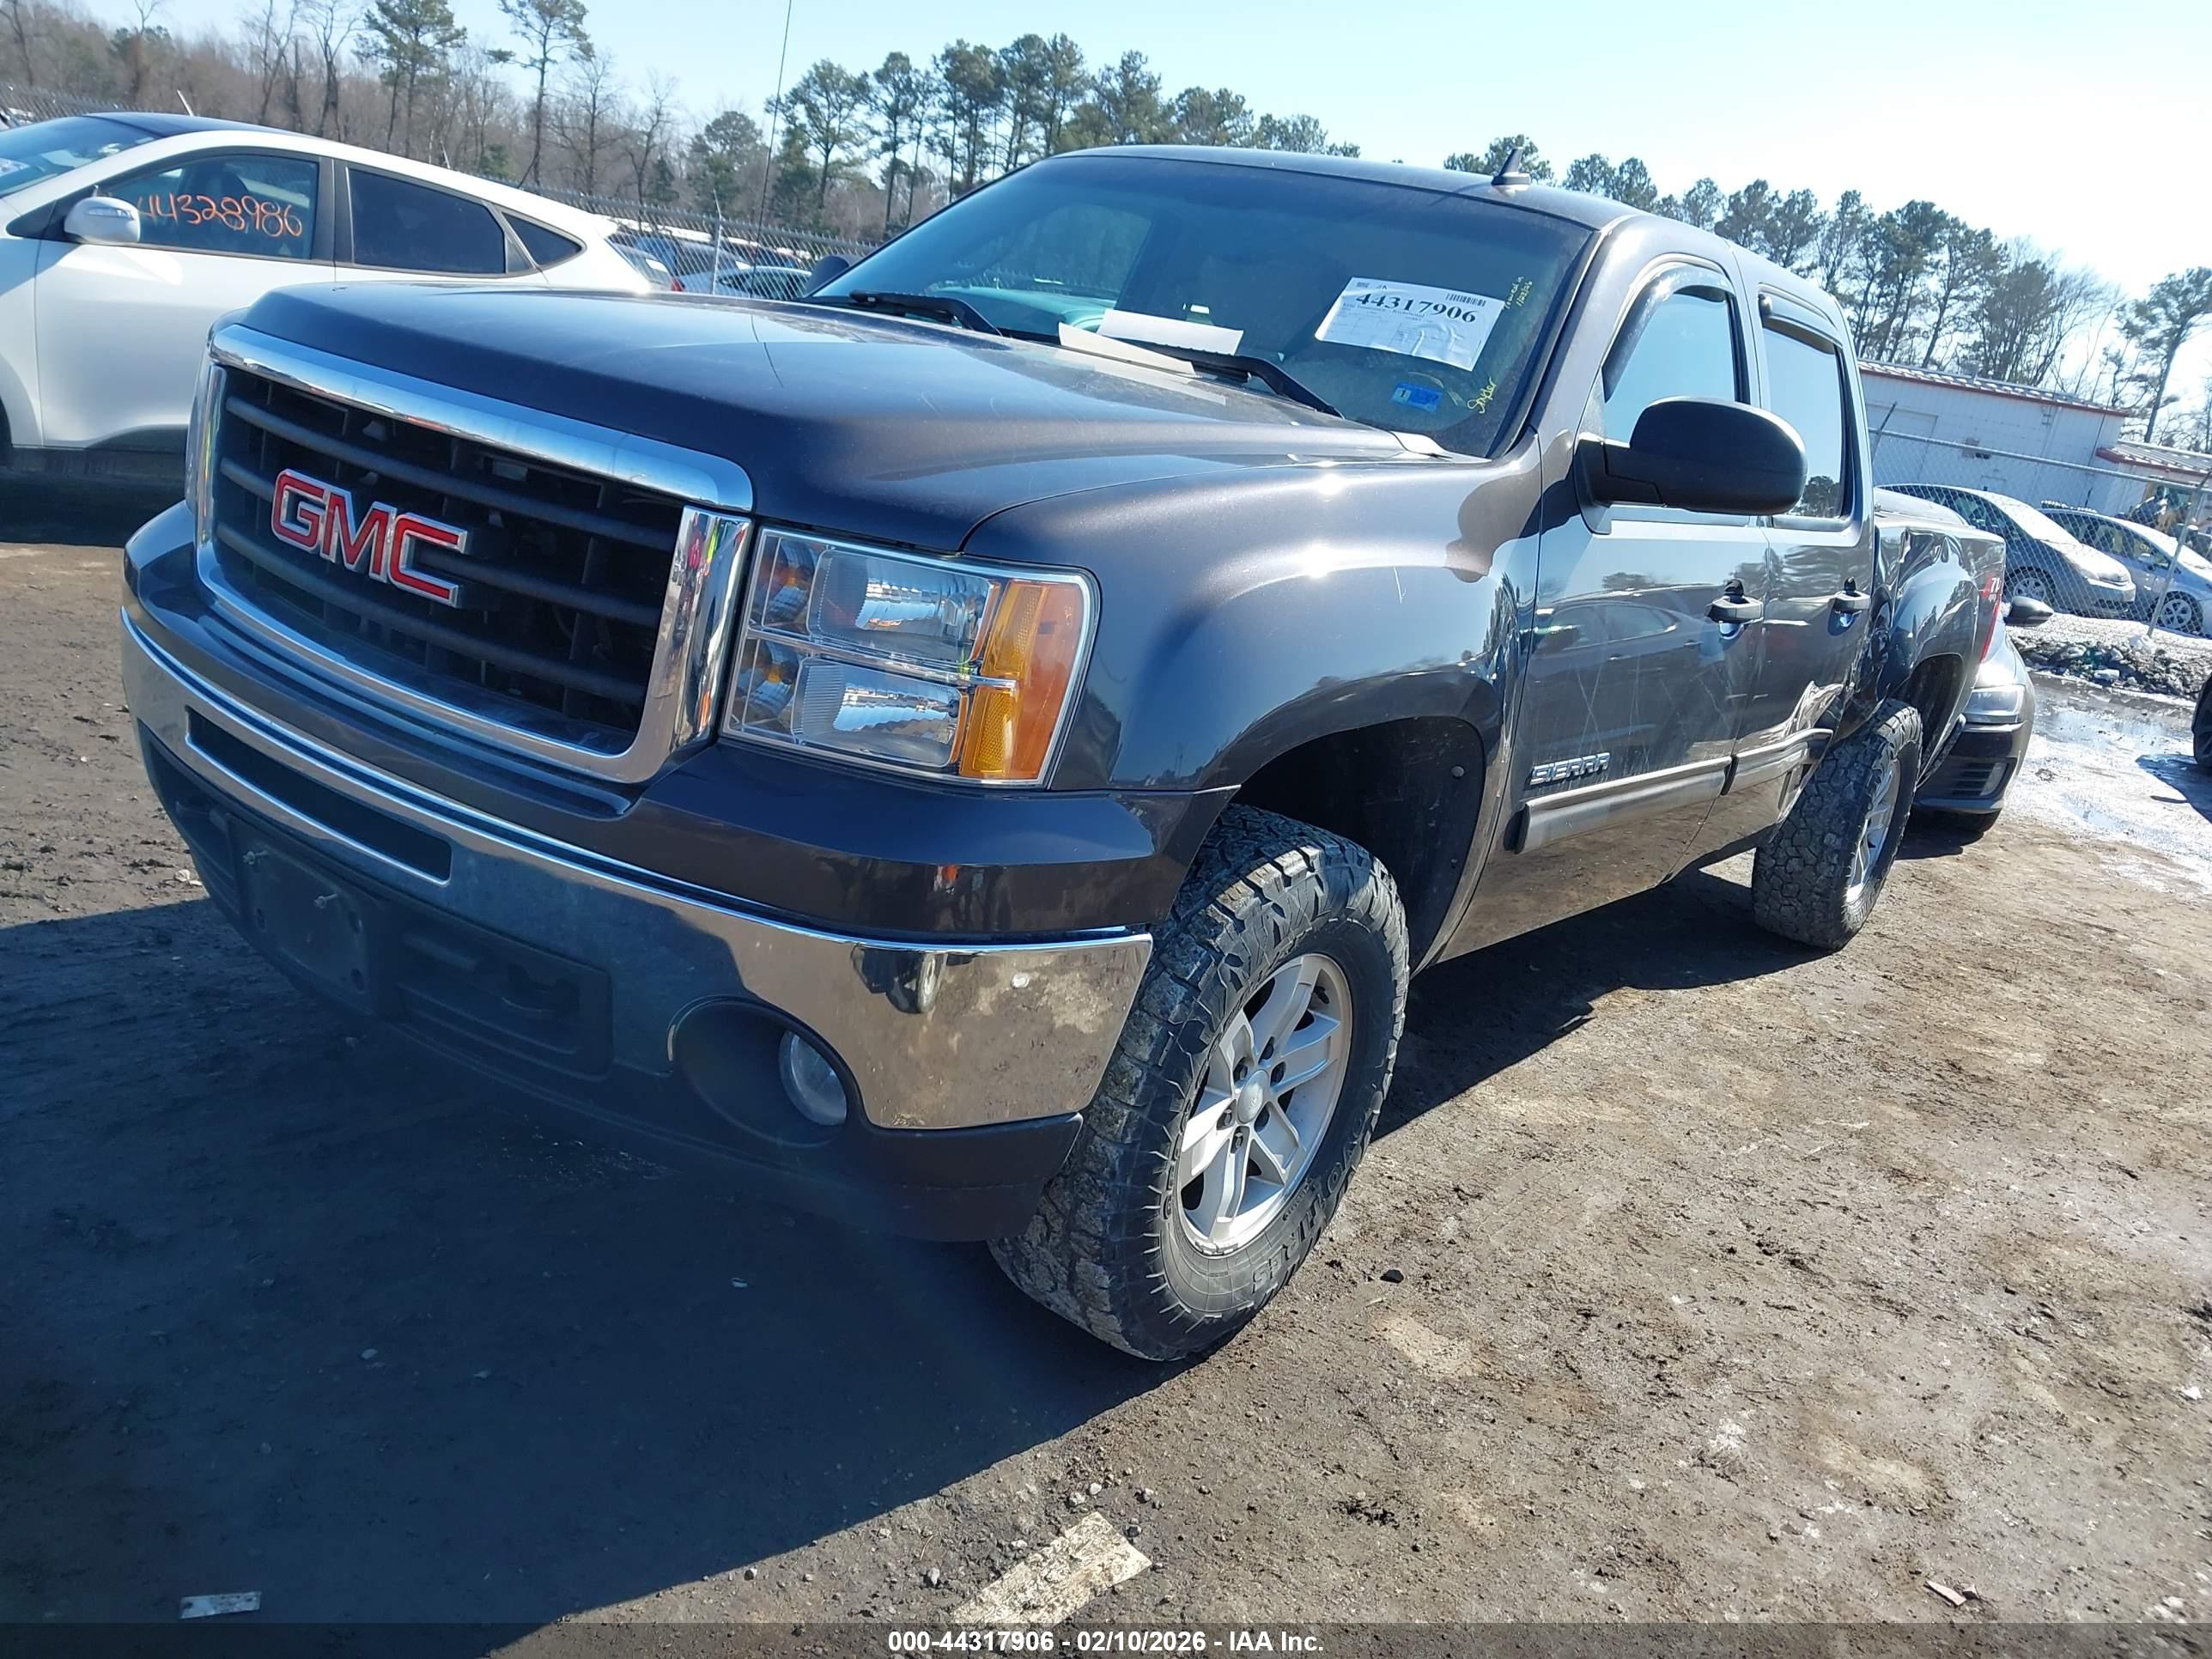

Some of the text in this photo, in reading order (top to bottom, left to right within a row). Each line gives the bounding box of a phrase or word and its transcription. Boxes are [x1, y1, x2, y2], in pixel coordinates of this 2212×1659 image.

[1356, 293, 1478, 323] 44317906
[271, 468, 468, 609] GMC
[1529, 751, 1611, 787] SIERRA
